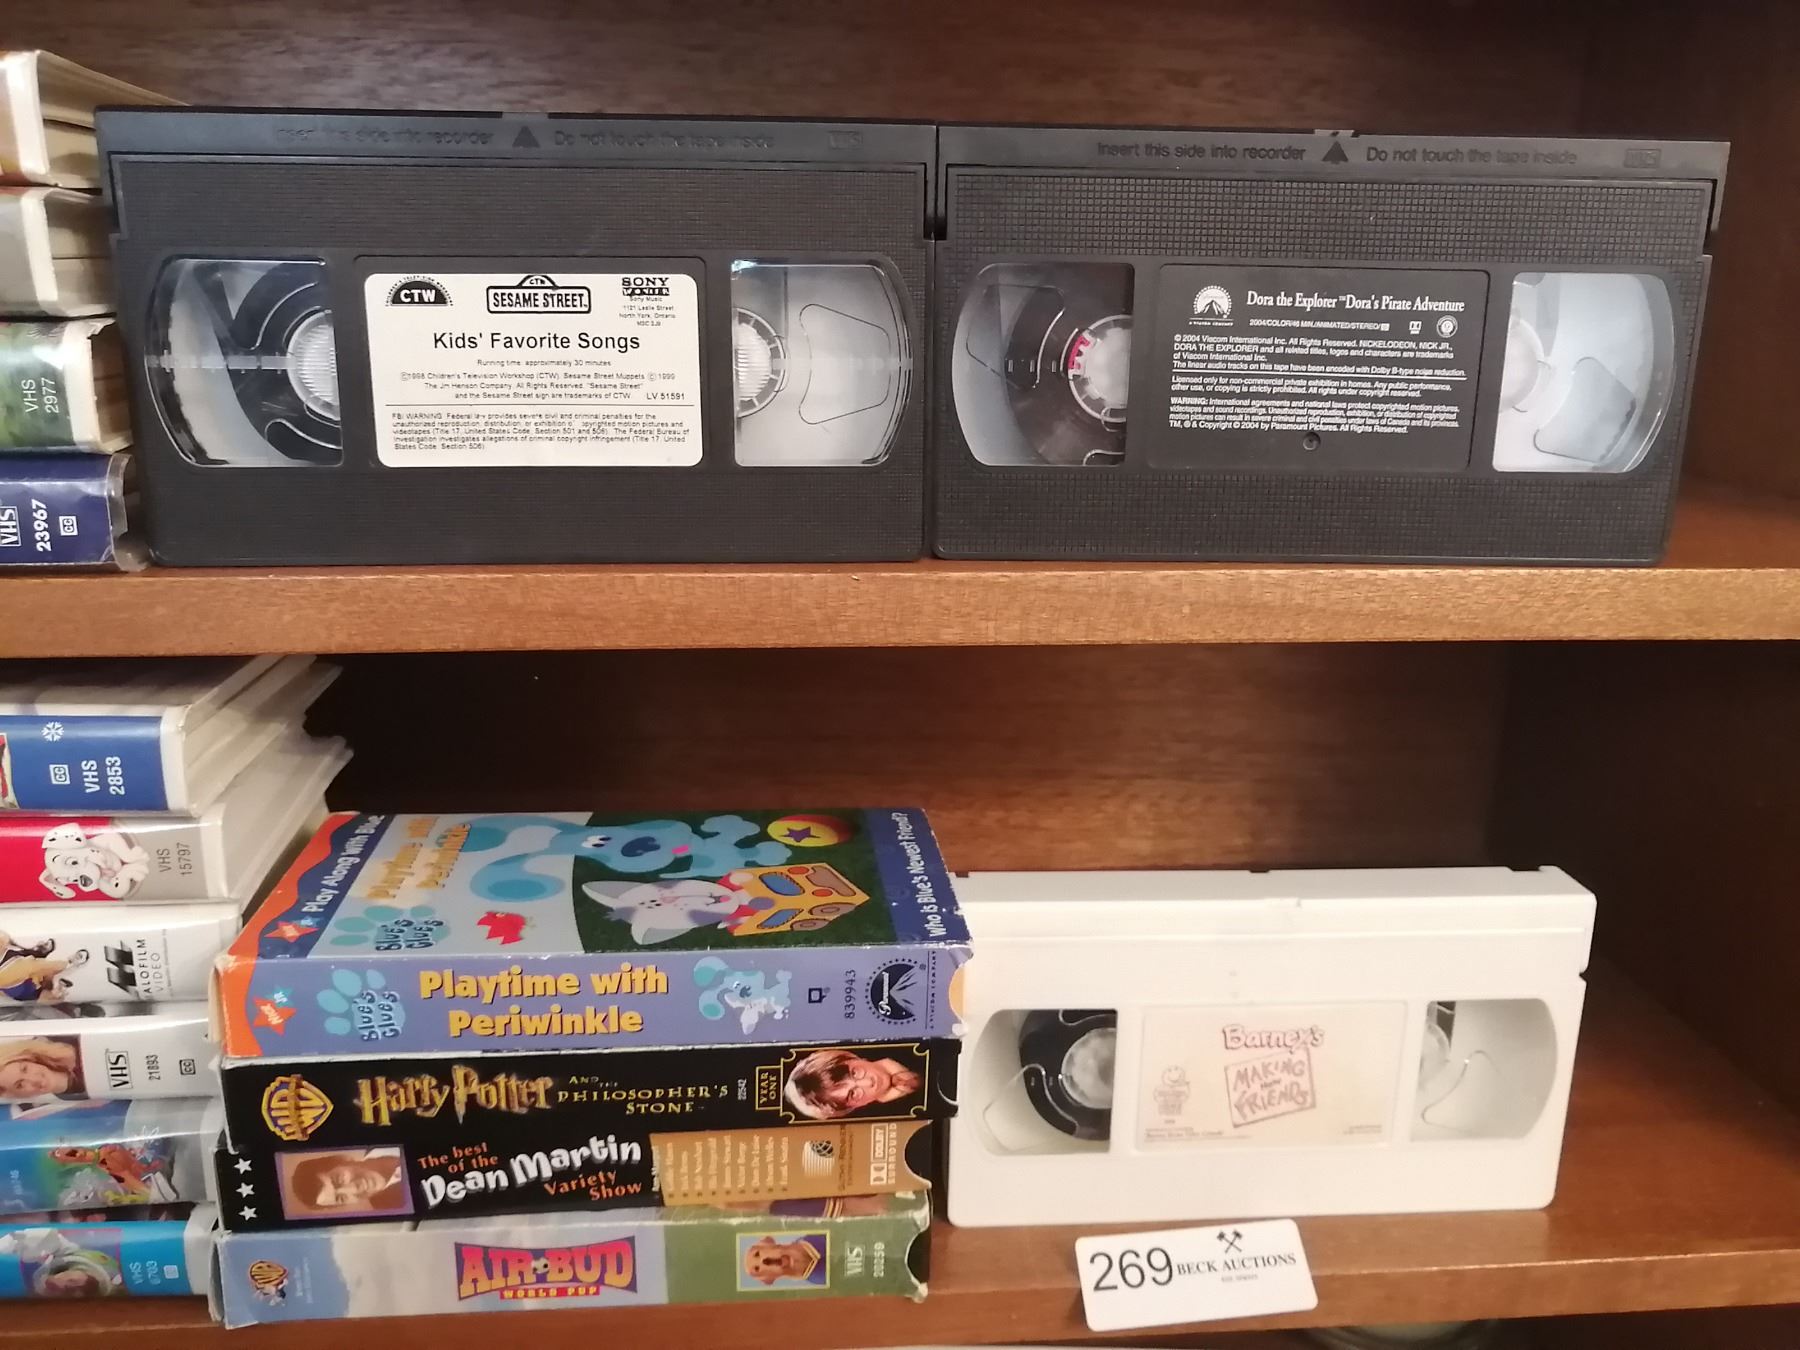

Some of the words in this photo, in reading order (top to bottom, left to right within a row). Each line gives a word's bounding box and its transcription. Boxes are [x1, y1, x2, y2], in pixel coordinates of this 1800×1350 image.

[554, 130, 575, 146] Do
[1145, 143, 1170, 158] this
[1175, 144, 1205, 159] side
[1211, 145, 1238, 160] into
[1242, 145, 1306, 161] recorder
[1366, 146, 1388, 162] Do
[1392, 147, 1417, 163] not
[1422, 148, 1465, 164] touch
[1469, 149, 1491, 164] the
[622, 277, 670, 287] SONY
[400, 289, 436, 303] CTW
[493, 292, 539, 308] SESAME
[543, 293, 584, 308] STREET
[1246, 290, 1274, 306] Dora
[1276, 291, 1293, 307] the
[1294, 292, 1338, 312] Explorer
[1345, 294, 1380, 310] Dora's
[1381, 295, 1412, 311] Pirate
[1412, 296, 1465, 312] Adventure
[433, 332, 483, 349] Kids'
[490, 332, 571, 349] Favorite
[578, 332, 640, 354] Songs
[1174, 343, 1198, 352] DORA
[1199, 343, 1215, 352] THE
[1216, 344, 1259, 353] EXPLORER
[1260, 345, 1274, 354] and
[1285, 346, 1309, 355] related
[1329, 348, 1349, 358] logos
[1349, 348, 1364, 357] and
[1365, 349, 1402, 358] characters
[1416, 350, 1455, 360] trademarks
[1182, 334, 1200, 343] 2004
[1201, 335, 1228, 344] Viacom
[1229, 336, 1274, 345] International
[1275, 337, 1287, 345] Inc.
[1288, 337, 1298, 346] All
[1299, 338, 1322, 347] Rights
[1322, 339, 1358, 348] Reserved.
[1359, 340, 1418, 350] NICKELODEON,
[1419, 342, 1439, 350] NICK
[427, 372, 461, 380] Children's
[463, 372, 498, 380] Television
[500, 372, 535, 381] Workshop
[477, 359, 505, 367] Running
[525, 359, 572, 367] approximately
[1172, 360, 1187, 369] The
[1187, 361, 1207, 370] linear
[1207, 361, 1227, 370] audio
[1227, 362, 1248, 371] tracks
[1325, 365, 1356, 374] encoded
[1371, 366, 1391, 376] Dolby
[526, 382, 548, 391] Rights
[616, 373, 645, 381] Muppets
[21, 378, 38, 413] VHS
[41, 377, 60, 414] 2977
[535, 392, 550, 400] sign
[647, 392, 659, 400] LV
[660, 392, 685, 400] 51591
[1199, 421, 1233, 431] Copyright
[1241, 421, 1260, 430] 2004
[1270, 422, 1308, 431] Paramount
[0, 507, 18, 546] VHS
[31, 499, 52, 552] 23967
[81, 759, 101, 793] VHS
[105, 756, 125, 796] 2853
[892, 812, 916, 841] Friend?
[156, 848, 172, 873] VHS
[176, 842, 193, 877] 15797
[901, 841, 925, 875] Newest
[302, 886, 340, 914] Play
[322, 854, 361, 889] Along
[912, 873, 937, 904] Blue's
[920, 902, 938, 915] is
[924, 914, 948, 937] Who
[136, 939, 153, 999] ALOFILM
[151, 952, 164, 992] VIDEO
[419, 964, 581, 1005] Playtime
[590, 961, 669, 995] with
[843, 968, 856, 1020] 839943
[878, 970, 892, 1016] Paramount
[449, 1003, 644, 1038] Periwinkle
[1223, 1023, 1325, 1054] Barney's
[109, 1053, 130, 1088] VHS
[146, 1054, 161, 1081] 21893
[569, 1075, 599, 1085] AND
[1233, 1058, 1306, 1092] MAKING
[354, 1074, 450, 1126] Harry
[452, 1064, 554, 1124] Potter
[557, 1084, 729, 1103] PHILOSOPHER'S
[760, 1072, 769, 1104] YEAR
[769, 1075, 777, 1099] ONE
[1234, 1080, 1310, 1121] FRIENDS
[626, 1101, 694, 1115] STONE
[418, 1152, 449, 1170] The
[452, 1141, 489, 1159] best
[873, 1128, 884, 1159] DOLBY
[888, 1123, 897, 1185] SURROUND
[421, 1167, 509, 1209] Dean
[510, 1133, 642, 1186] Martin
[448, 1159, 465, 1174] of
[471, 1153, 499, 1174] the
[544, 1169, 617, 1196] Variety
[589, 1180, 642, 1201] Show
[129, 1261, 144, 1285] VHS
[459, 1245, 537, 1299] AIR
[544, 1240, 634, 1288] BUD
[846, 1246, 863, 1275] VHS
[1089, 1247, 1174, 1292] 269
[1176, 1260, 1218, 1276] BECK
[1222, 1253, 1297, 1272] AUCTIONS
[503, 1287, 558, 1299] WORLD
[567, 1286, 598, 1296] PUP
